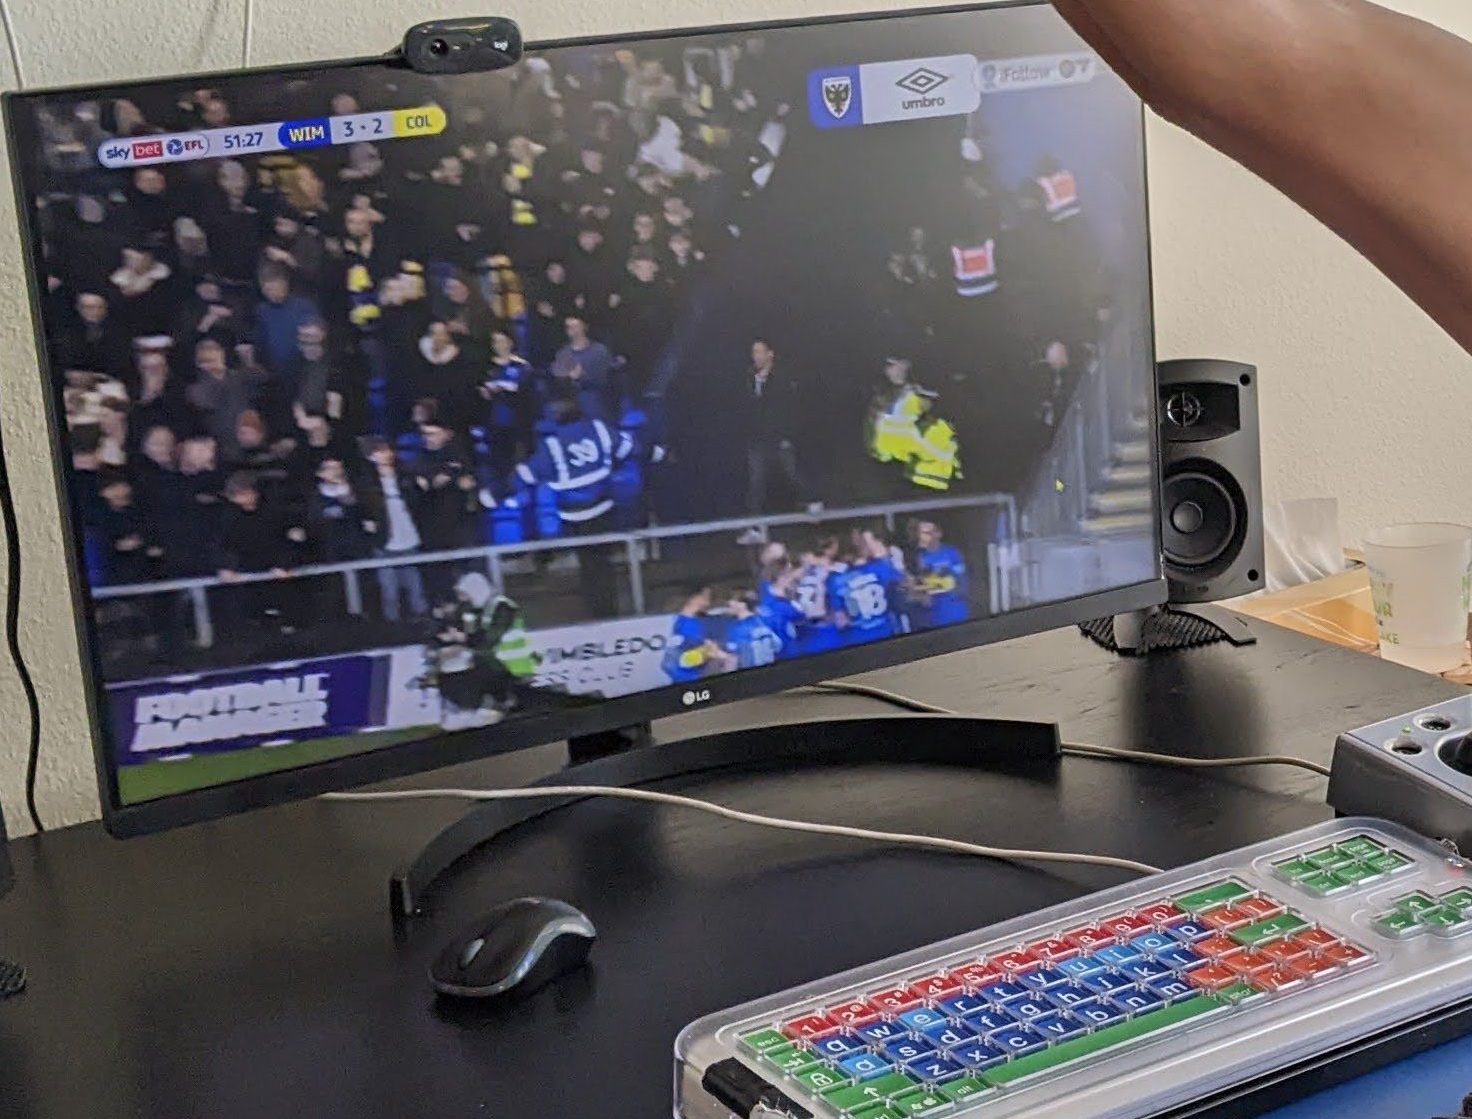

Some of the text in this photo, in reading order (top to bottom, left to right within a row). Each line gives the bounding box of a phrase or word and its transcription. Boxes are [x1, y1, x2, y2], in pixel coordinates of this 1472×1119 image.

[105, 144, 131, 161] sky
[134, 142, 161, 157] bet
[184, 138, 205, 152] EFL
[223, 131, 264, 150] 51:27
[288, 124, 326, 142] WIM
[405, 114, 434, 129] COL
[902, 95, 946, 111] umbro
[826, 925, 1198, 1052] q w e r t y u i o p
[855, 1058, 877, 1071] a
[898, 1046, 918, 1057] s
[940, 1030, 961, 1045] d
[980, 1015, 997, 1028] f
[1020, 1003, 1041, 1016] g
[1057, 991, 1081, 1004] h
[1097, 976, 1113, 989] j
[1133, 966, 1157, 977] k
[925, 982, 1188, 1076] z x c v b n m
